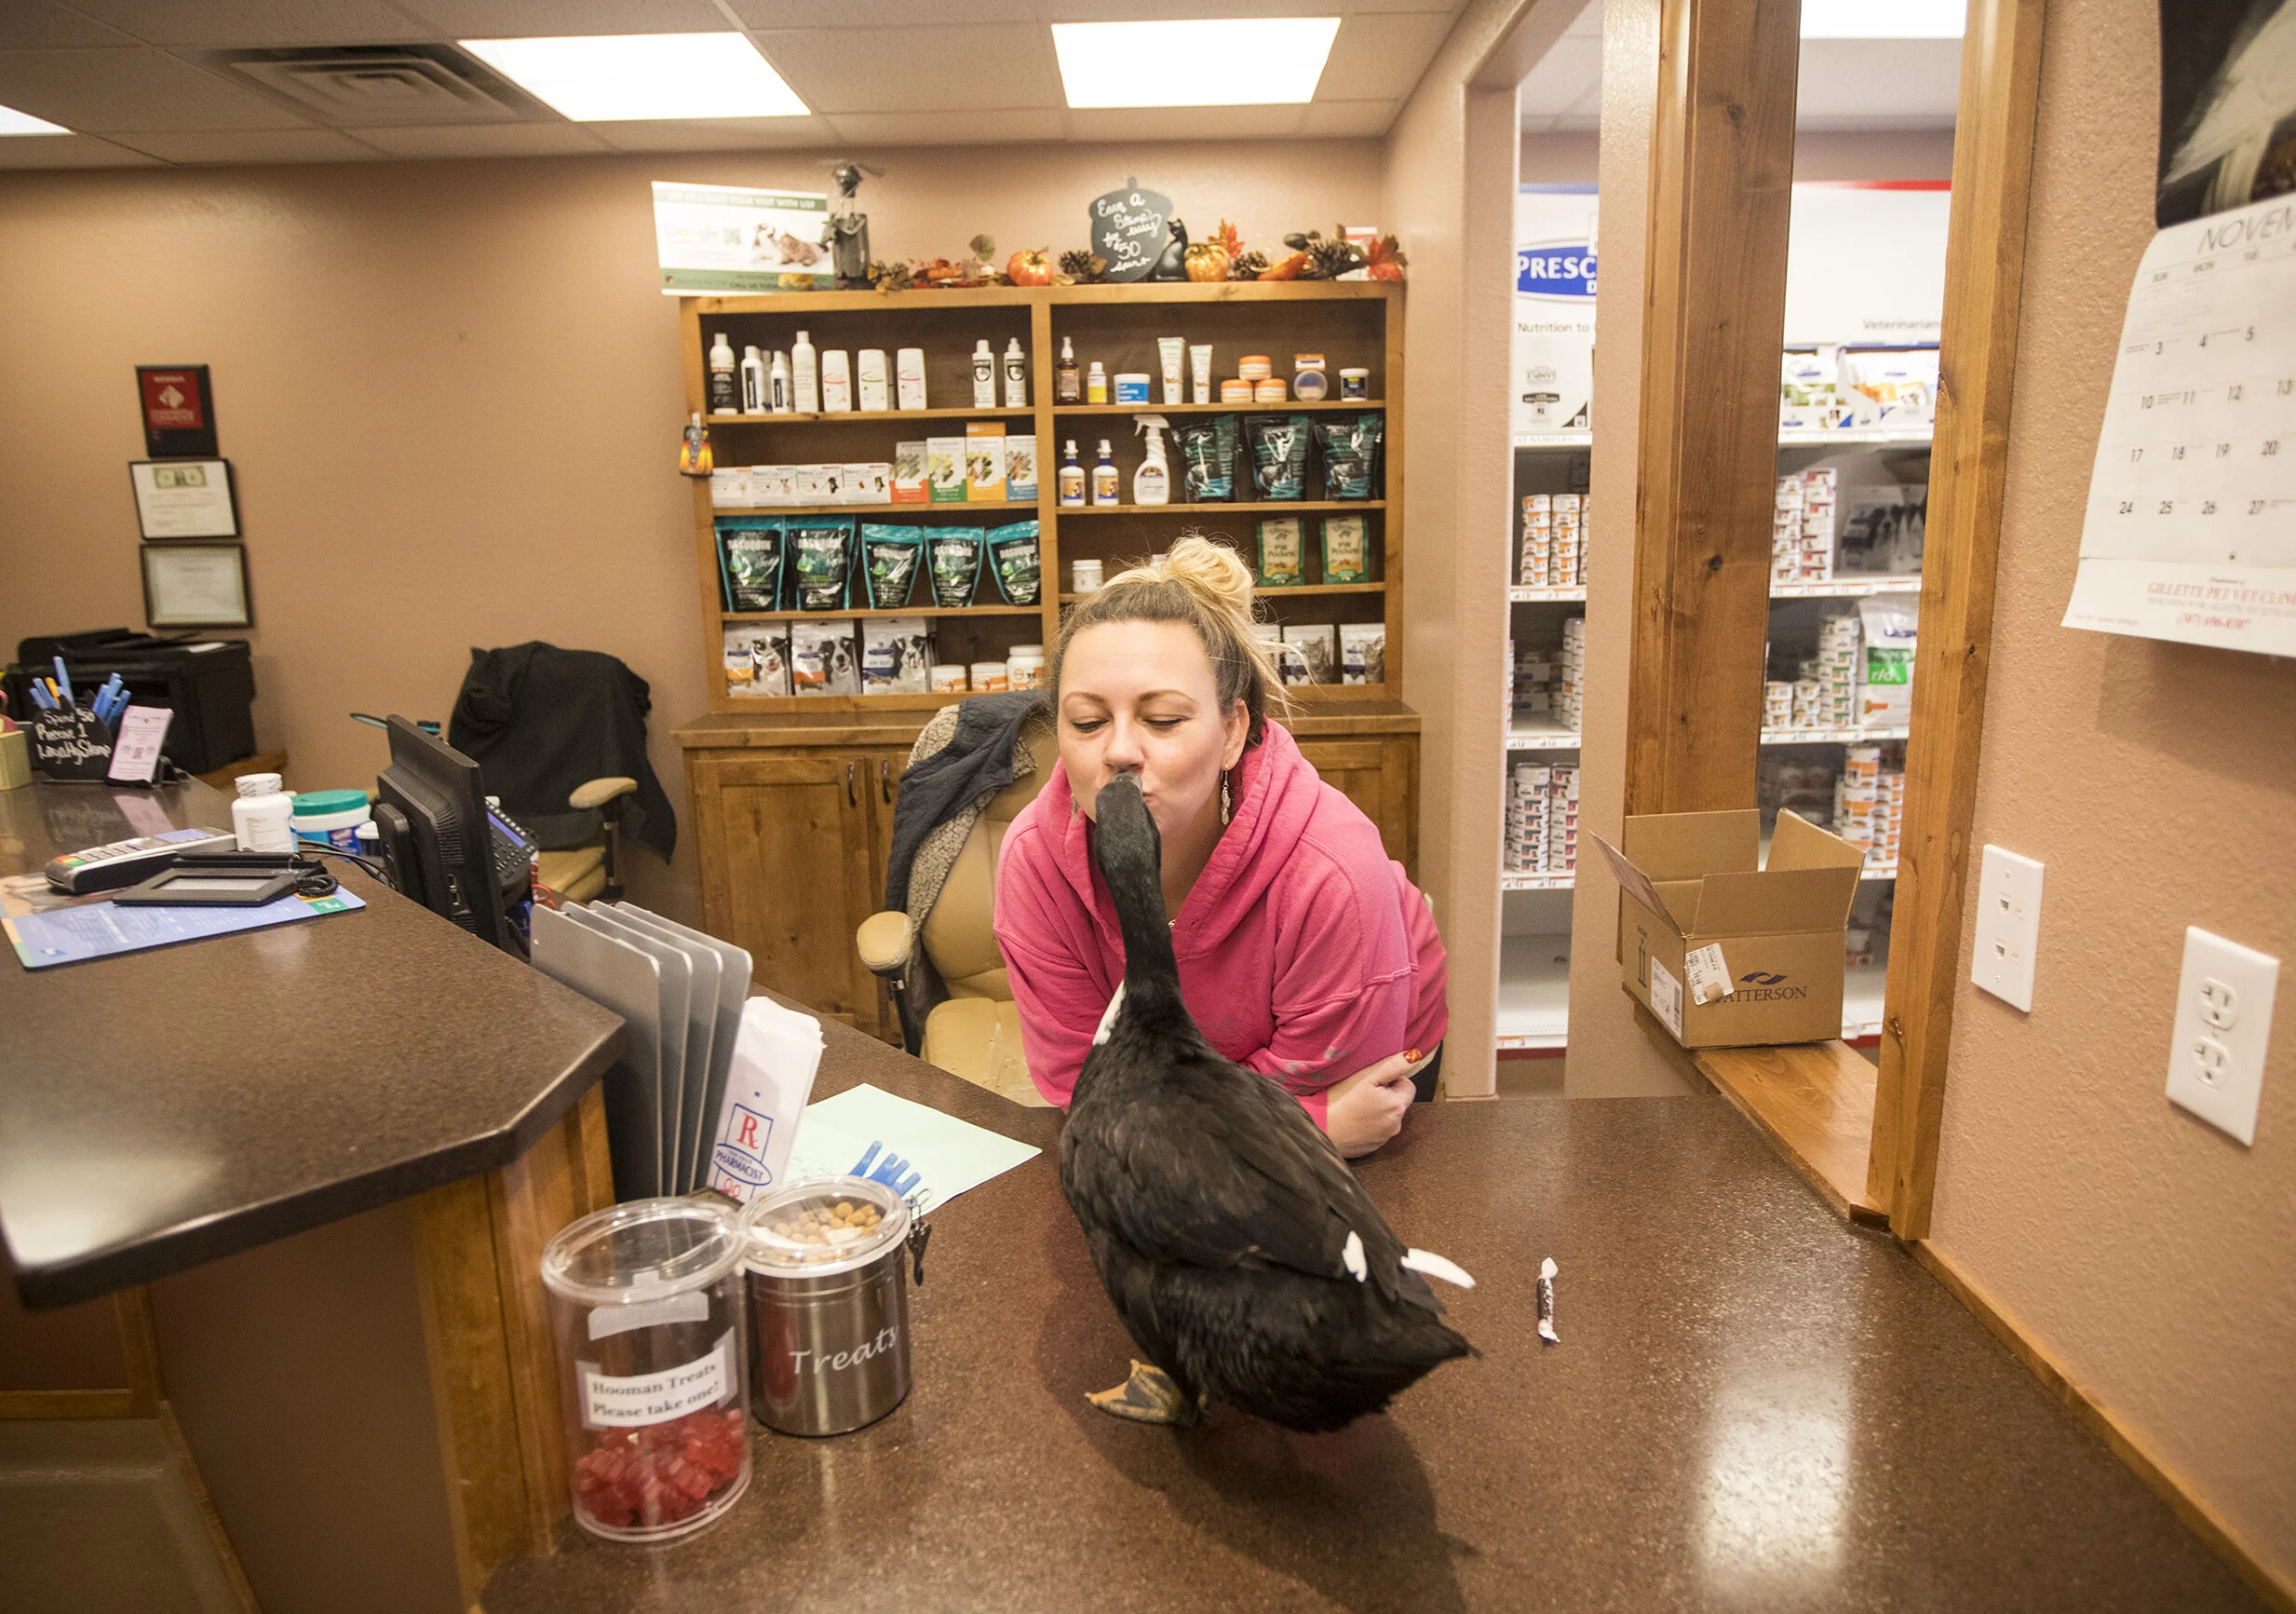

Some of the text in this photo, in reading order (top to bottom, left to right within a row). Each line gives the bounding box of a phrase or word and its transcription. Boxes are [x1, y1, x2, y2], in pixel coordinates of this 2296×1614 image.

[776, 198, 798, 208] WITH
[1518, 322, 1590, 332] Nutrition to
[2154, 327, 2254, 355] 3 4 5
[2141, 380, 2293, 409] 10 11 12 13
[2130, 441, 2278, 462] 17 18 19 20
[2119, 500, 2264, 515] 24 25 26 27
[2147, 582, 2204, 597] GILLETTE
[716, 1150, 763, 1181] PHARMACIST
[789, 1323, 899, 1375] Treats
[592, 1363, 716, 1396] Hooman Treats
[593, 1380, 720, 1417] Please take one!
